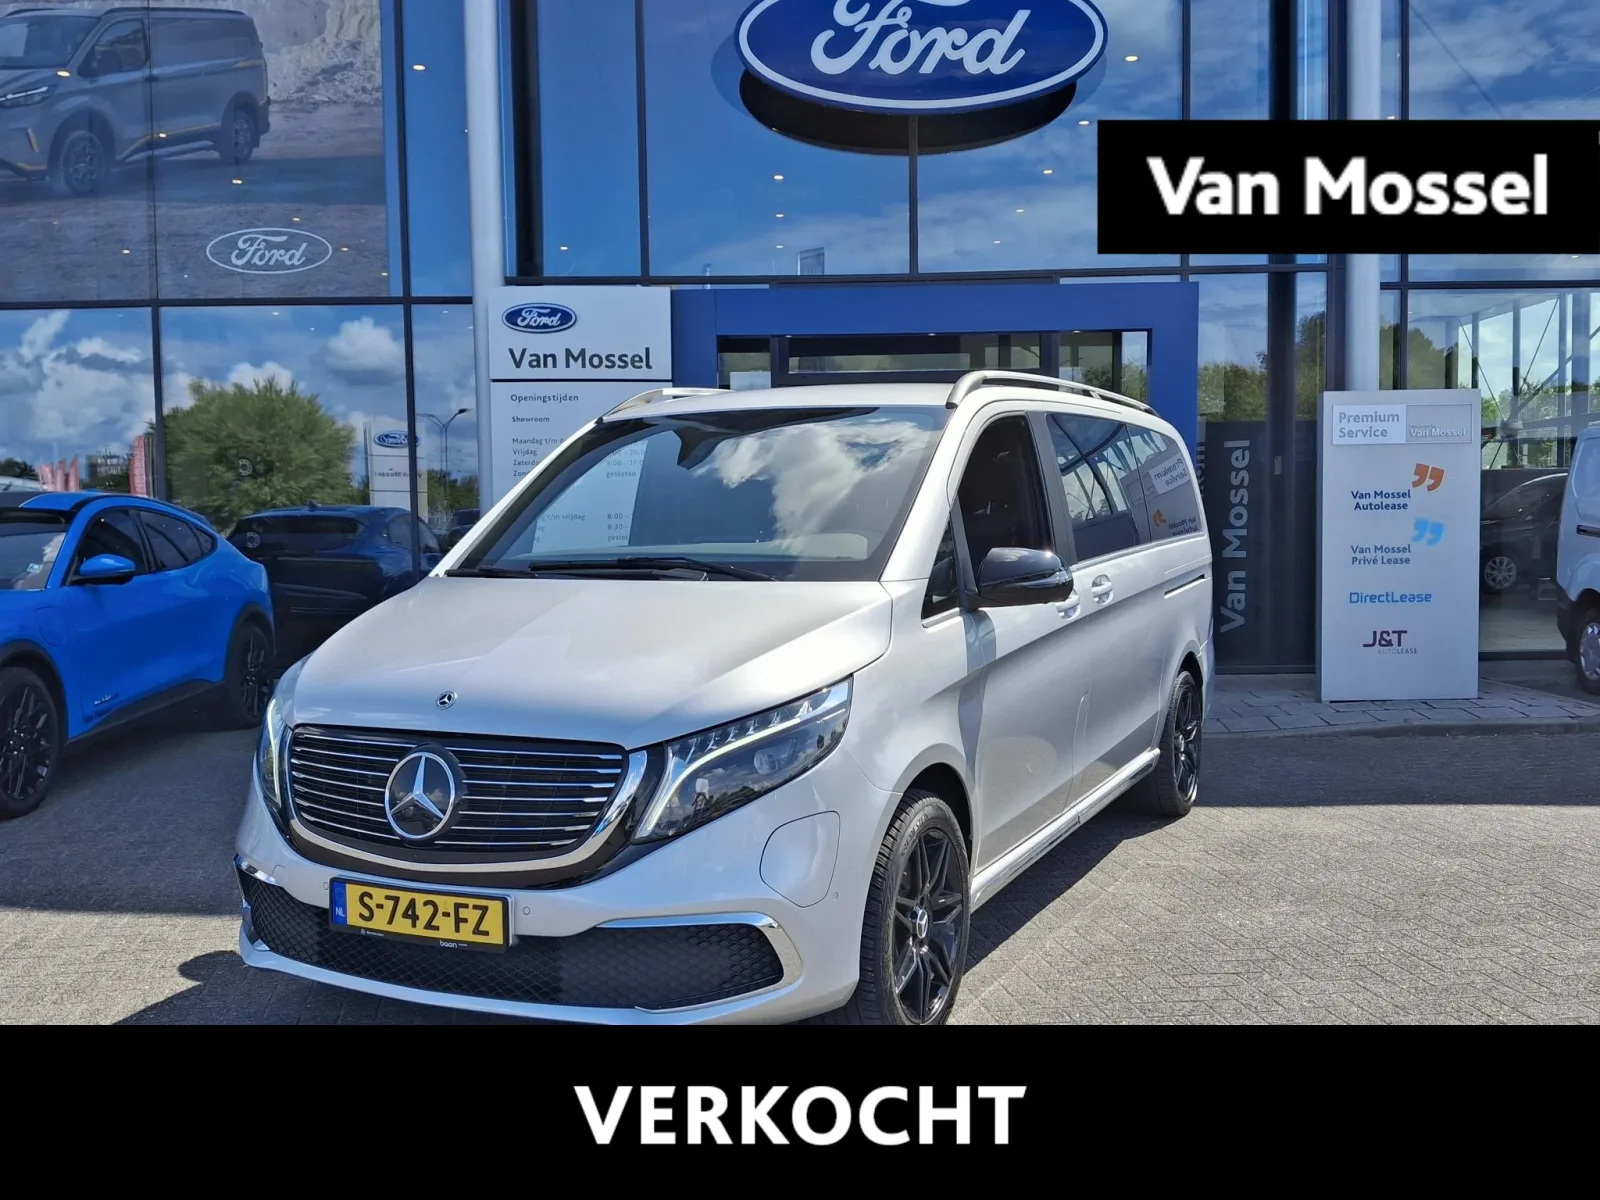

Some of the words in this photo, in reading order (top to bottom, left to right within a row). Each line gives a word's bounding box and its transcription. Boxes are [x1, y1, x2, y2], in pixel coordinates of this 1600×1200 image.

[811, 0, 1031, 75] Ford
[231, 234, 308, 265] Ford
[517, 307, 561, 327] Ford
[508, 348, 557, 369] Van
[565, 347, 652, 370] Mossel
[510, 393, 579, 403] Openingstijden
[1338, 411, 1400, 423] Premium
[1338, 426, 1388, 438] Service
[1409, 428, 1429, 437] Van
[1431, 427, 1467, 437] Mossel
[512, 437, 543, 445] Maandag
[512, 448, 538, 457] Vrijdag
[606, 470, 637, 479] gesloten
[1222, 440, 1250, 558] Mossel
[1351, 490, 1371, 499] Van
[1374, 489, 1411, 499] Mossel
[1354, 501, 1408, 511] Autolease
[561, 513, 586, 521] vrijdag
[607, 533, 628, 542] geslot
[1351, 545, 1371, 554] Van
[1374, 544, 1411, 553] Mossel
[1351, 555, 1378, 565] Privé
[1381, 556, 1410, 564] Lease
[1220, 570, 1246, 632] Van
[1349, 592, 1432, 603] DirectLease
[1362, 630, 1407, 647] J&T
[335, 906, 345, 917] NL
[358, 891, 490, 937] S-742-FZ
